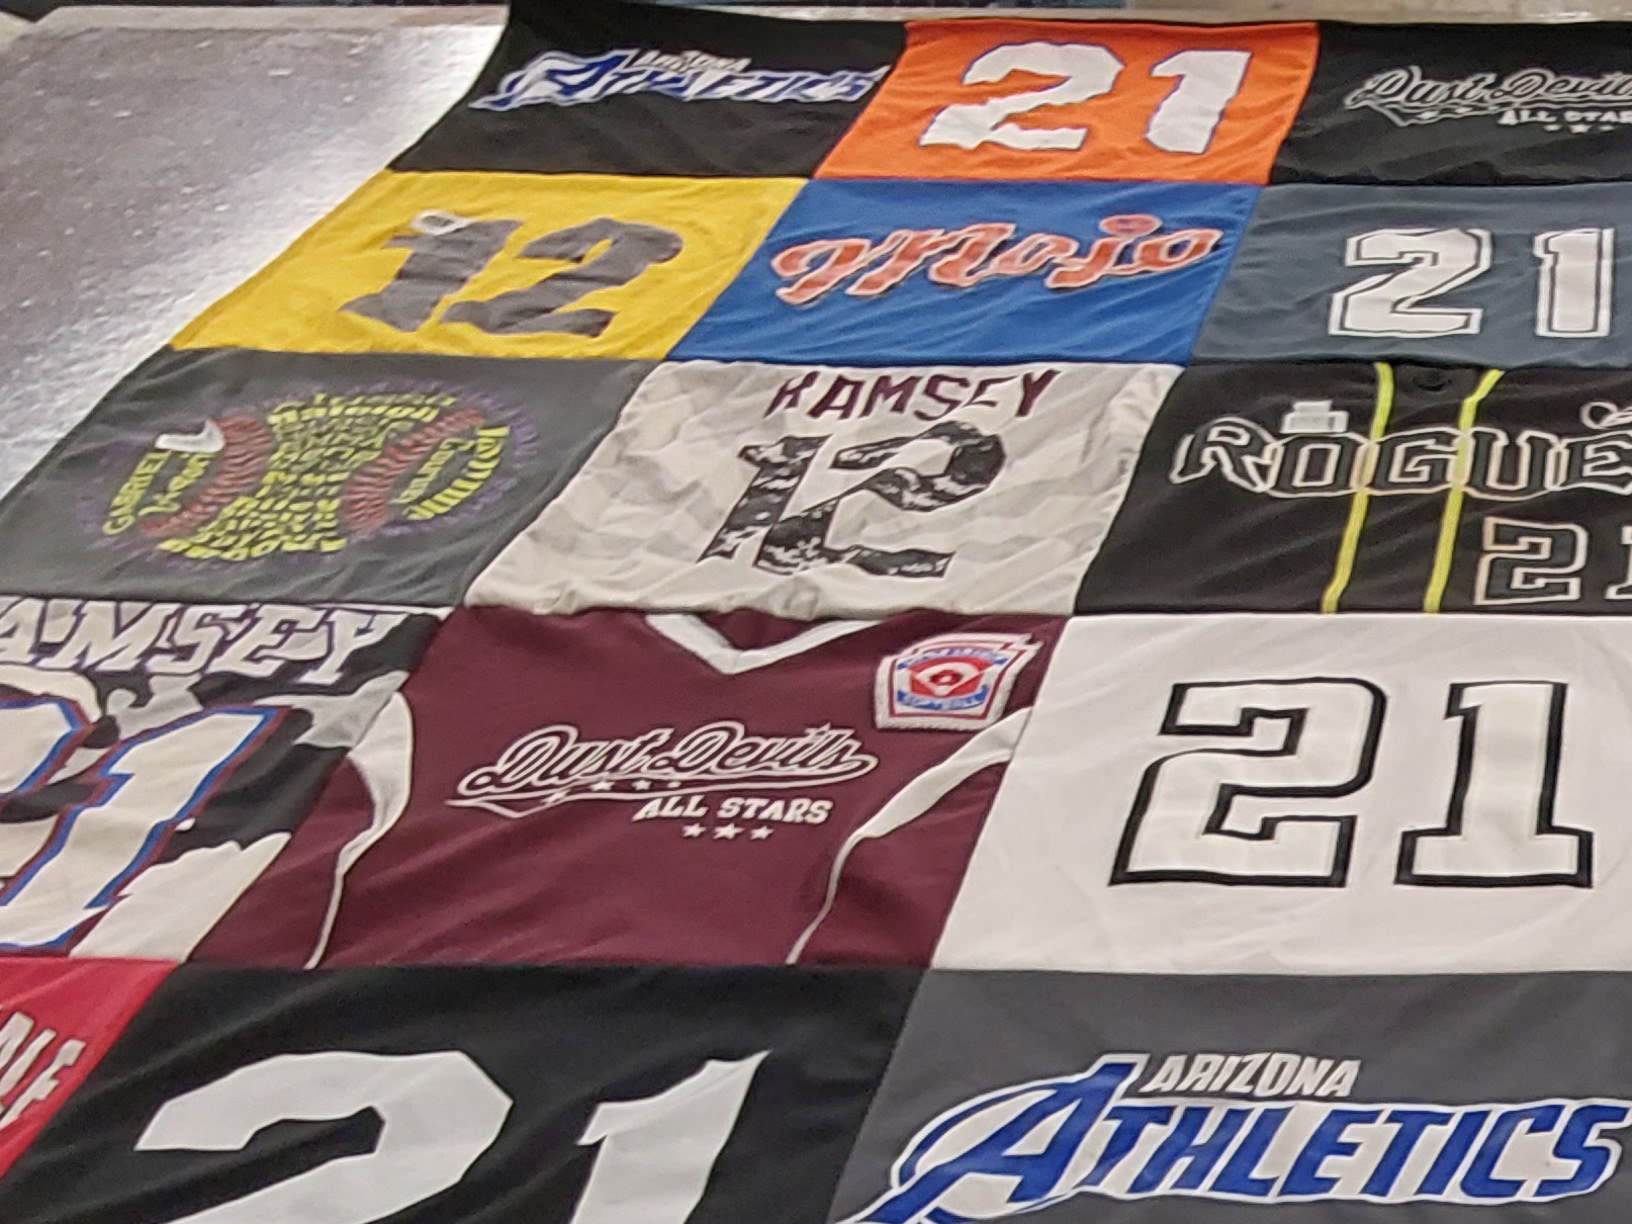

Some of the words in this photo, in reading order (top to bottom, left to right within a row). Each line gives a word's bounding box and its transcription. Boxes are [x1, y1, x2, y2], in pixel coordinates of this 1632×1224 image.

[918, 40, 1252, 153] 21
[1498, 110, 1555, 125] ALL
[337, 216, 685, 338] 12
[1328, 228, 1615, 338] 21
[763, 368, 1062, 422] RAMSEY
[696, 420, 1007, 579] 12
[632, 797, 709, 821] ALL
[717, 797, 834, 824] STARS
[1108, 675, 1595, 888] 21
[1140, 1051, 1363, 1098] ARIZONA
